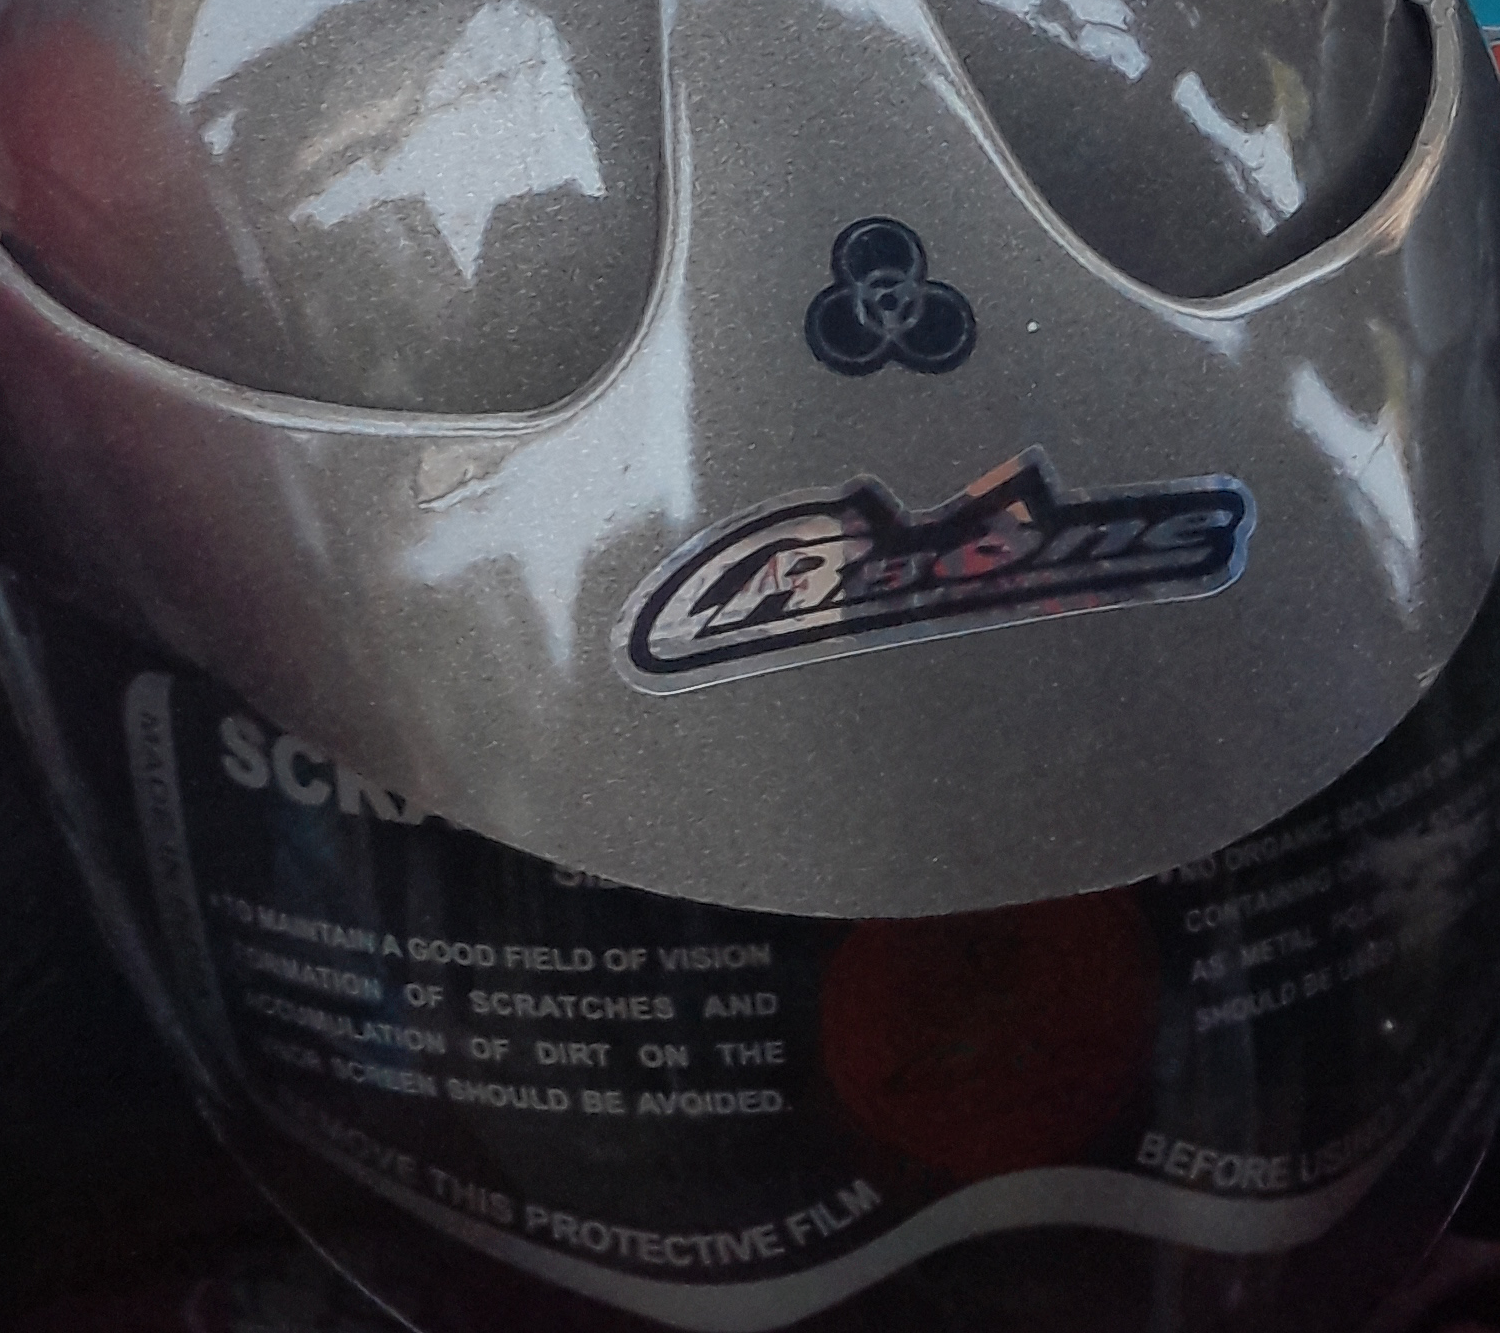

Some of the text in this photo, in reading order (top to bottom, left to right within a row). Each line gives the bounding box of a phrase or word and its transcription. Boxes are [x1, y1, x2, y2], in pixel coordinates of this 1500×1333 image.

[379, 931, 405, 960] A
[406, 936, 498, 971] GOOD
[503, 945, 598, 975] FIELD
[601, 946, 651, 974] OF
[654, 941, 775, 974] VISION
[403, 982, 445, 1010] OF
[467, 988, 677, 1023] SCRATCHES
[703, 989, 781, 1021] AND
[468, 1034, 512, 1065] OF
[533, 1039, 613, 1070] DIRT
[636, 1041, 692, 1071] ON
[714, 1037, 789, 1068] THE
[449, 1076, 571, 1114] SHOULD
[580, 1087, 628, 1117] BE
[1135, 1129, 1292, 1190] BEFORE
[426, 1164, 516, 1226] THIS
[522, 1201, 786, 1266] PROTECTIVE
[781, 1177, 885, 1248] FILM
